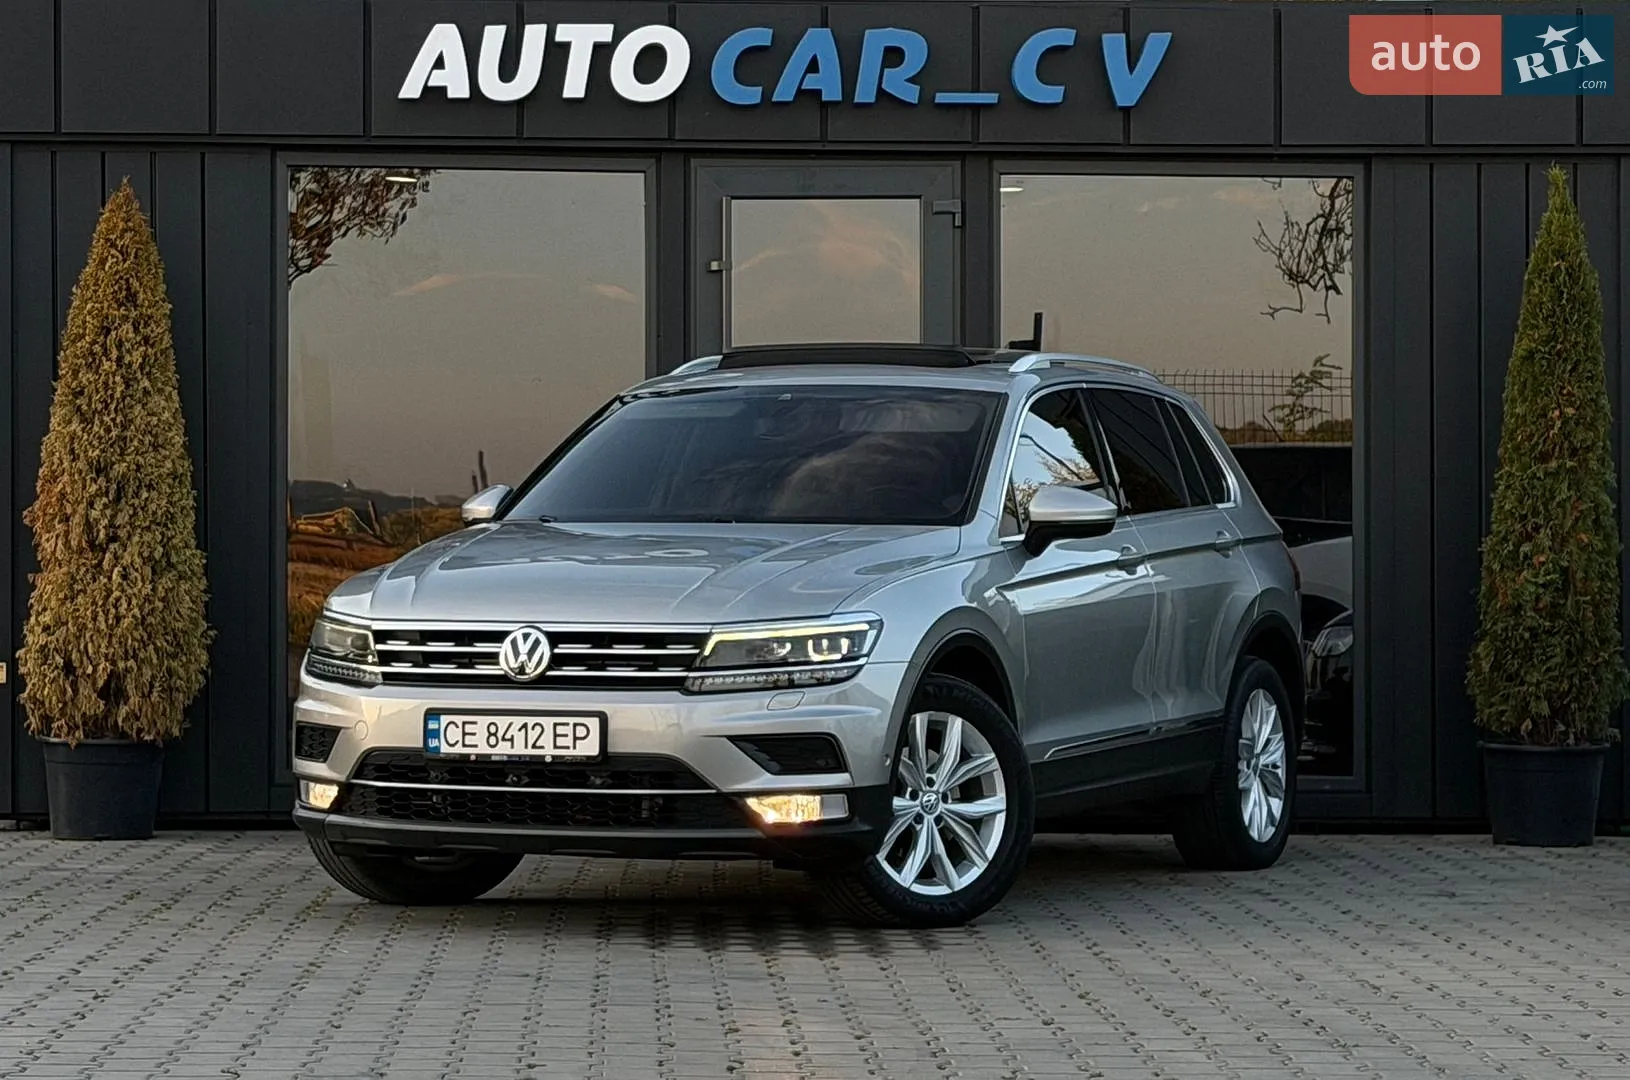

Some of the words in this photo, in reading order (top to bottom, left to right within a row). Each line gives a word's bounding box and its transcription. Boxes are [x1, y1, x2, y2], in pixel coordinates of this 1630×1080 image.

[398, 23, 690, 102] AUTO
[443, 720, 479, 749] CE
[486, 721, 545, 750] 8412
[552, 721, 591, 750] EP
